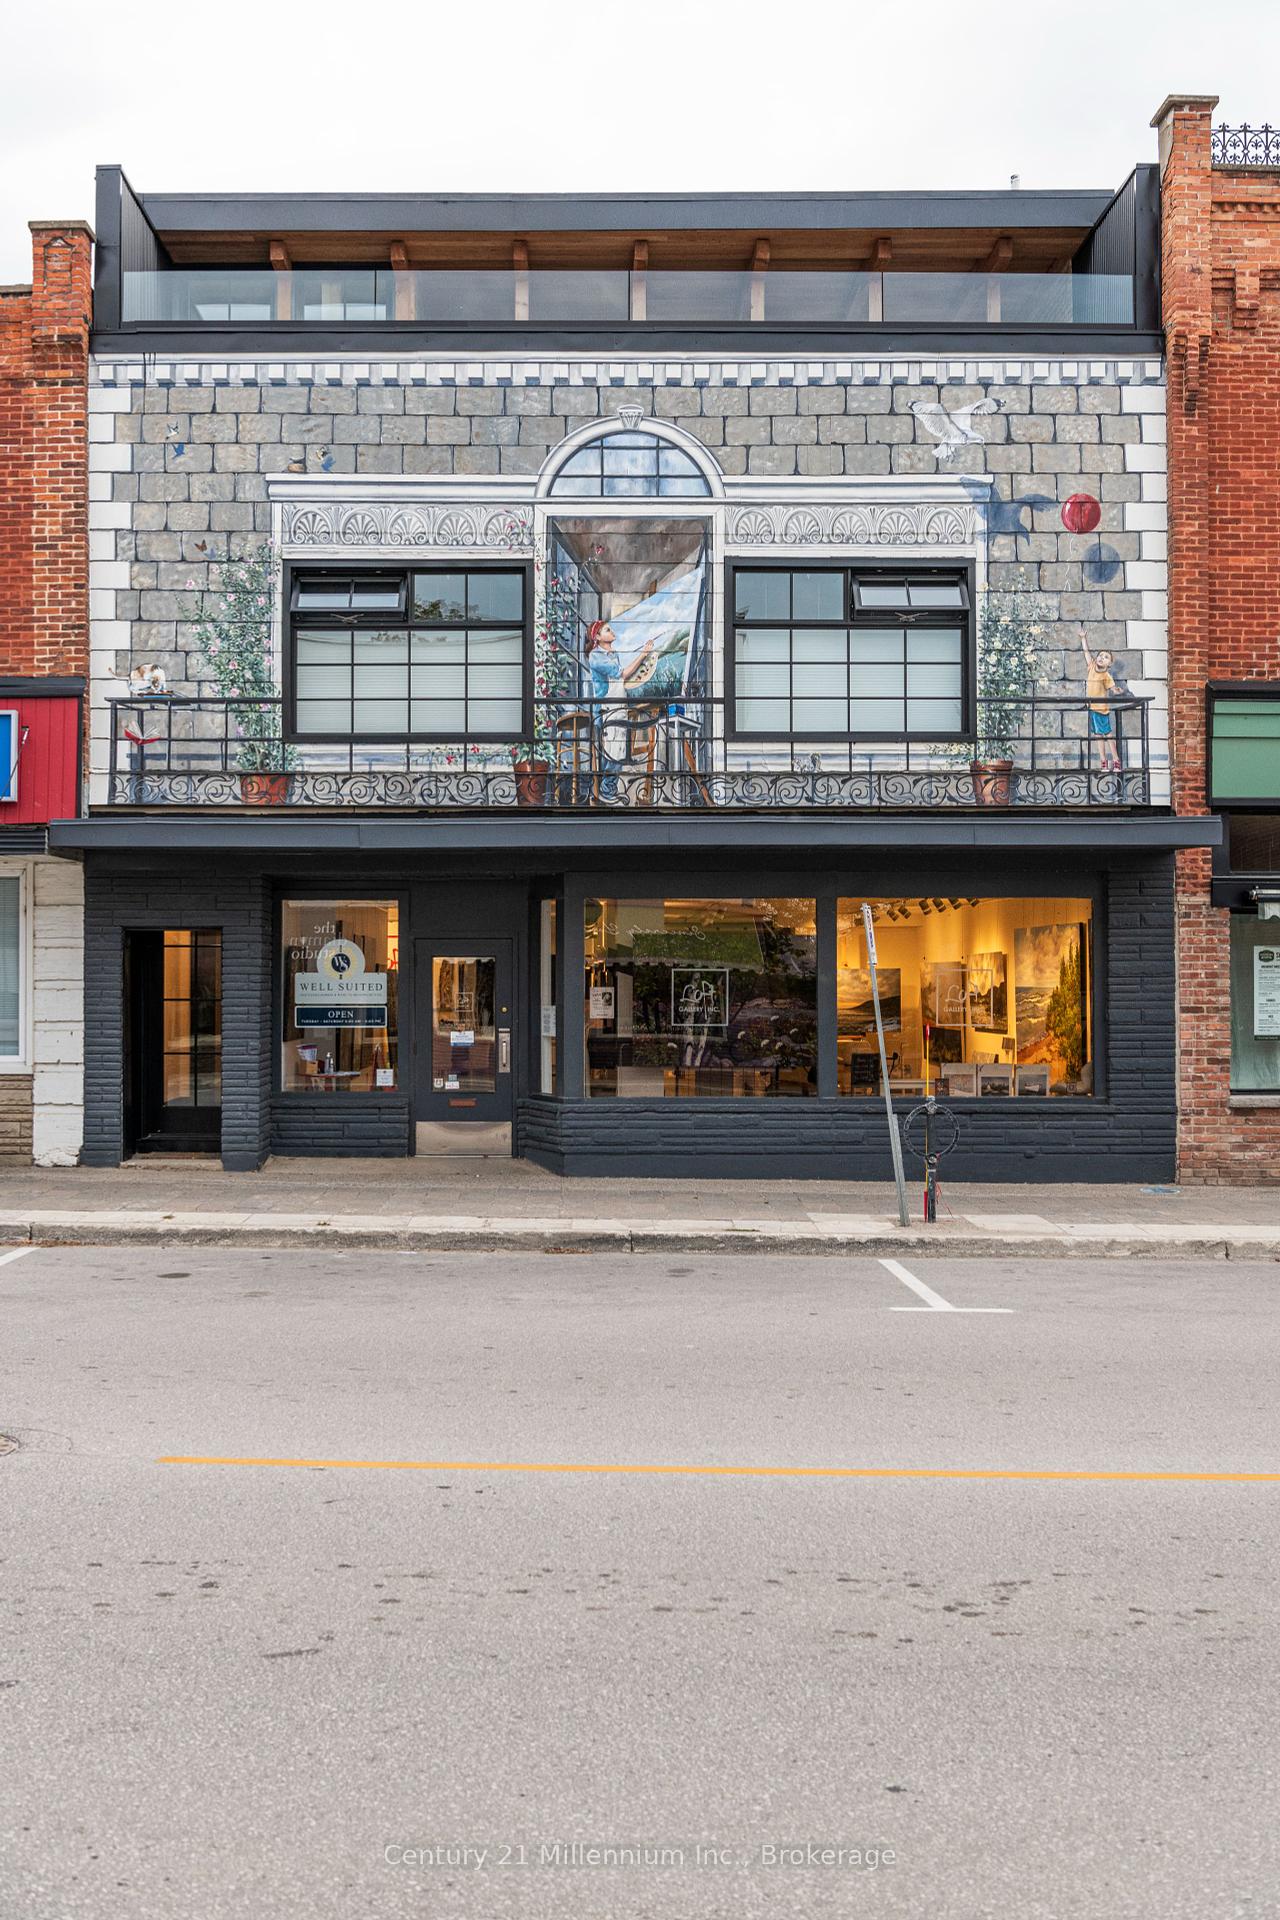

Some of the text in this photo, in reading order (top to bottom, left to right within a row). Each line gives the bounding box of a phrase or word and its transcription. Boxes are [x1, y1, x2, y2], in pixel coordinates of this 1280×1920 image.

[300, 982, 383, 992] WELL SUITED
[327, 1010, 354, 1018] OPEN
